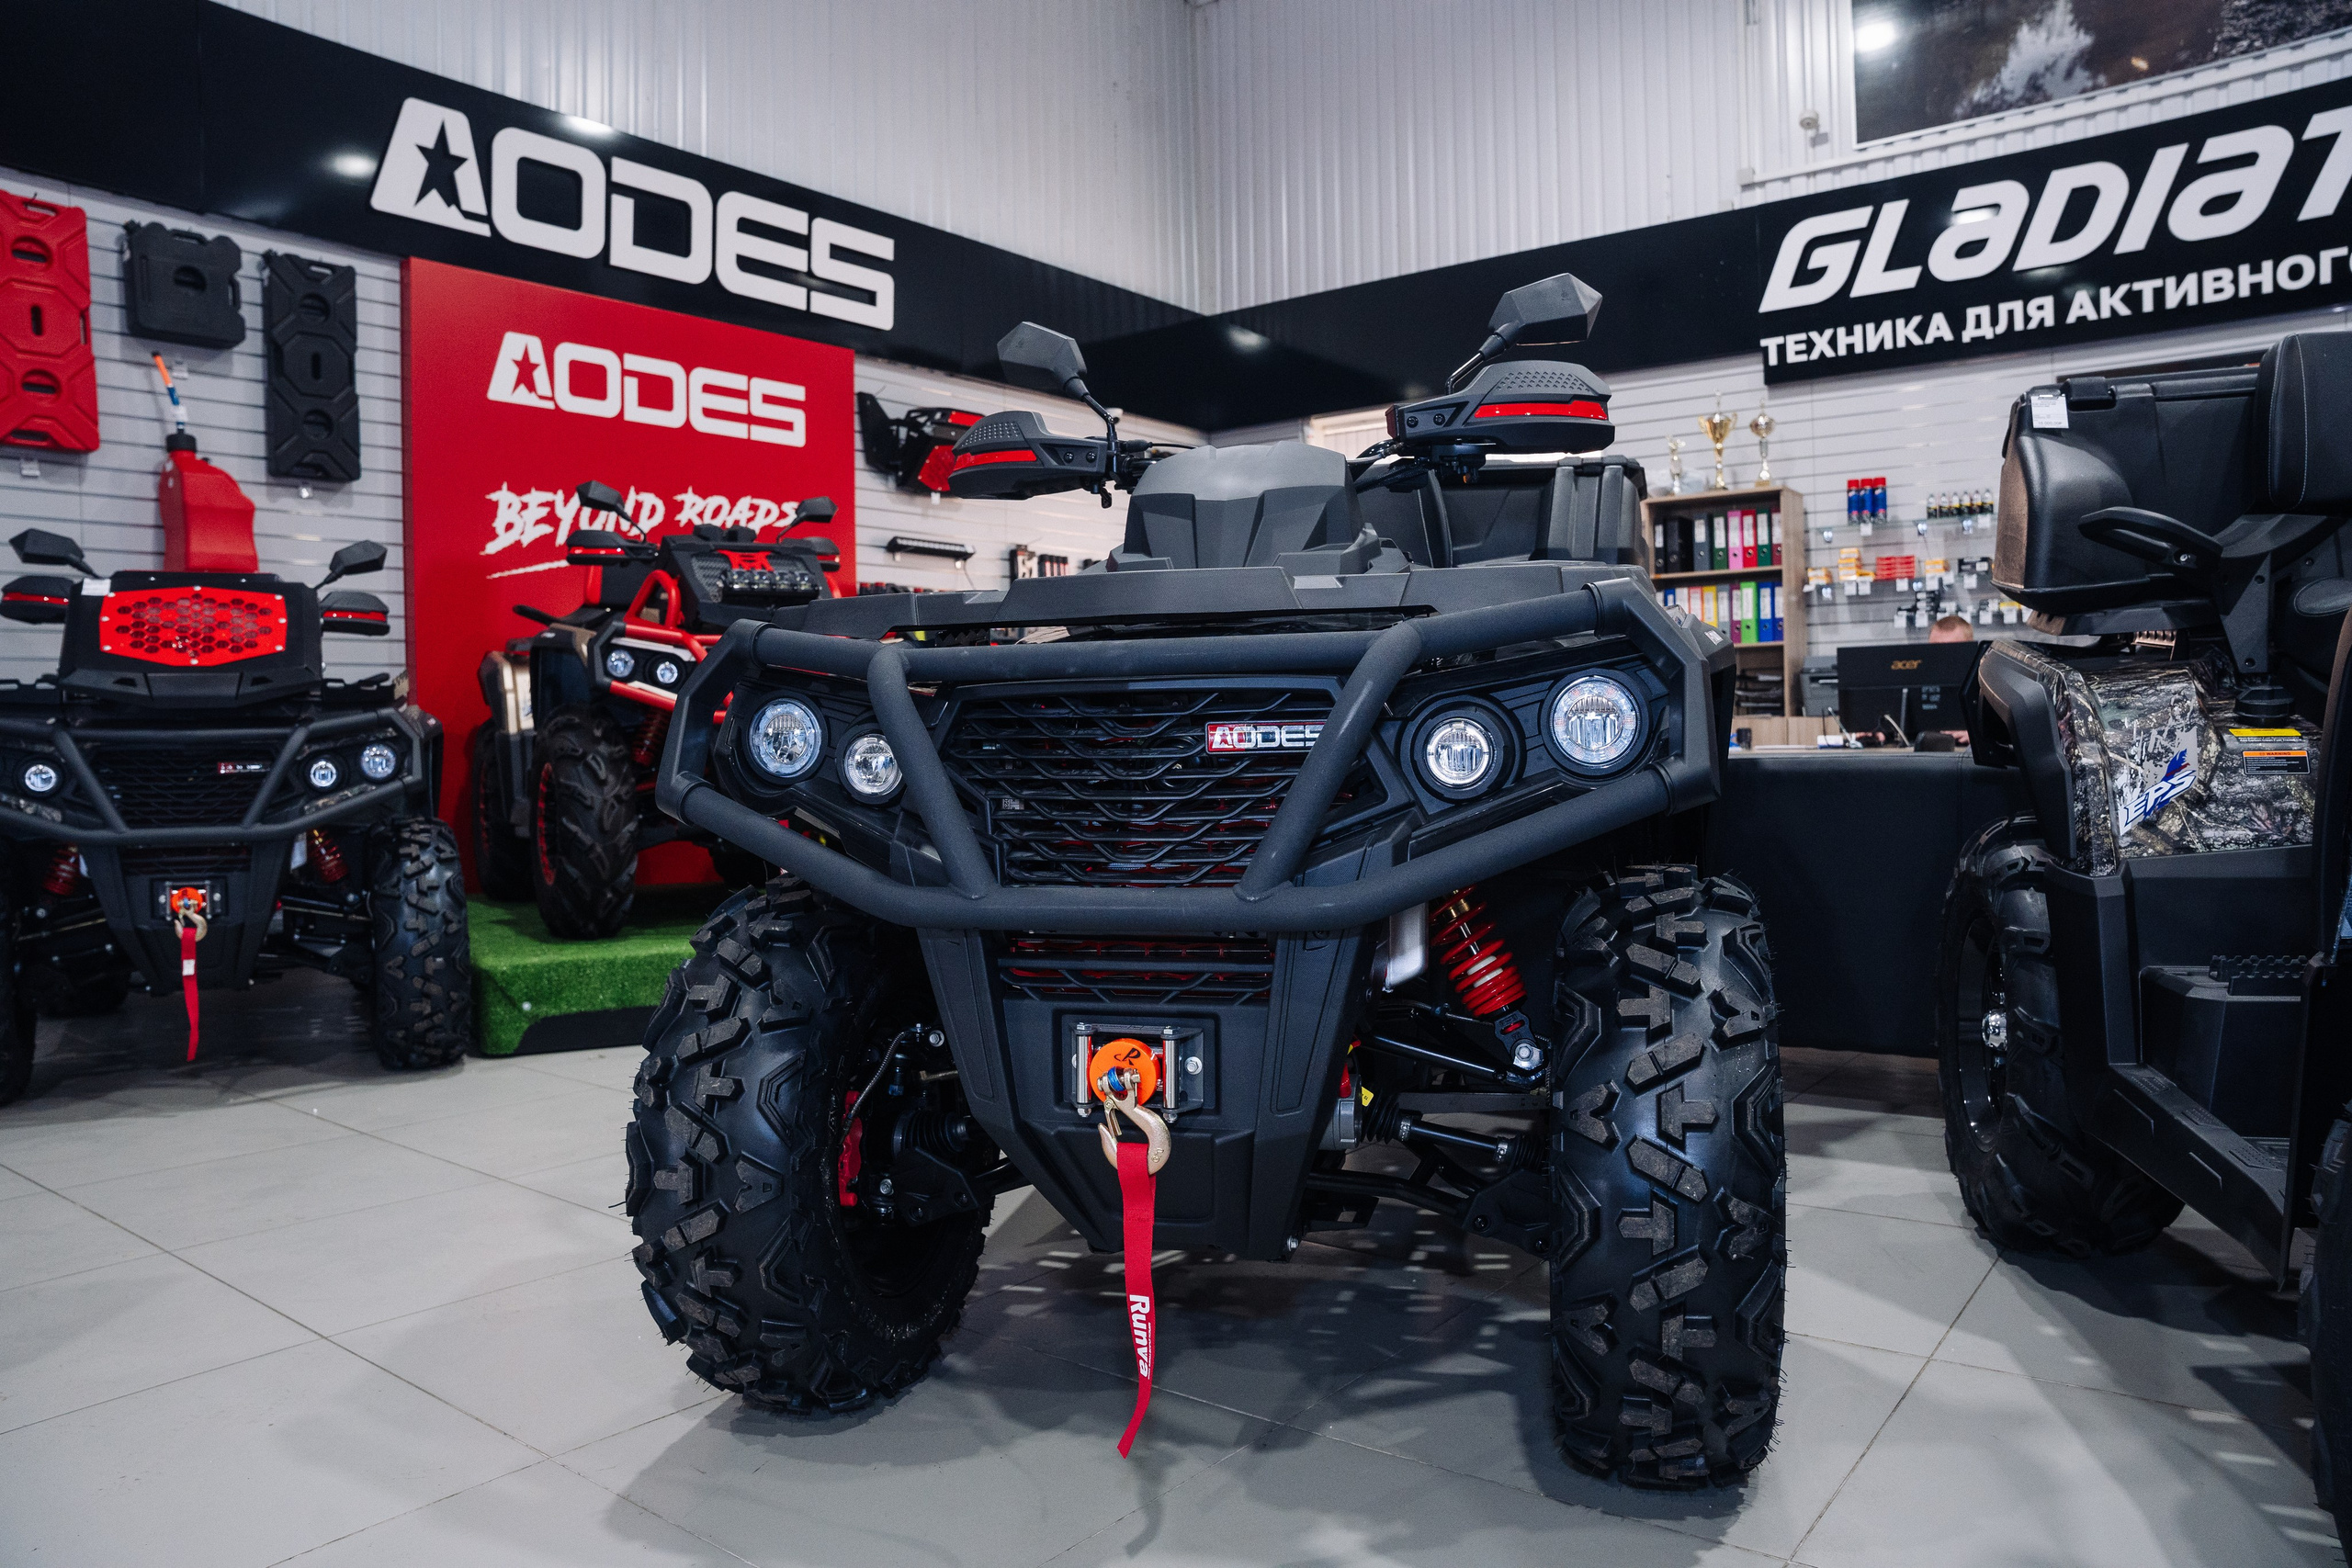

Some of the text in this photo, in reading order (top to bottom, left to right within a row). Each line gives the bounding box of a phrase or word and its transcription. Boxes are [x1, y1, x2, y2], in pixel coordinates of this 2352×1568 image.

[371, 98, 895, 330] AODES
[1760, 246, 2352, 366] ТЕХНИКА ДЛЯ АКТИВНОГ
[488, 332, 806, 447] AODES
[1890, 659, 1923, 671] acer
[2124, 770, 2197, 827] EPS
[1129, 1294, 1150, 1378] Runva
